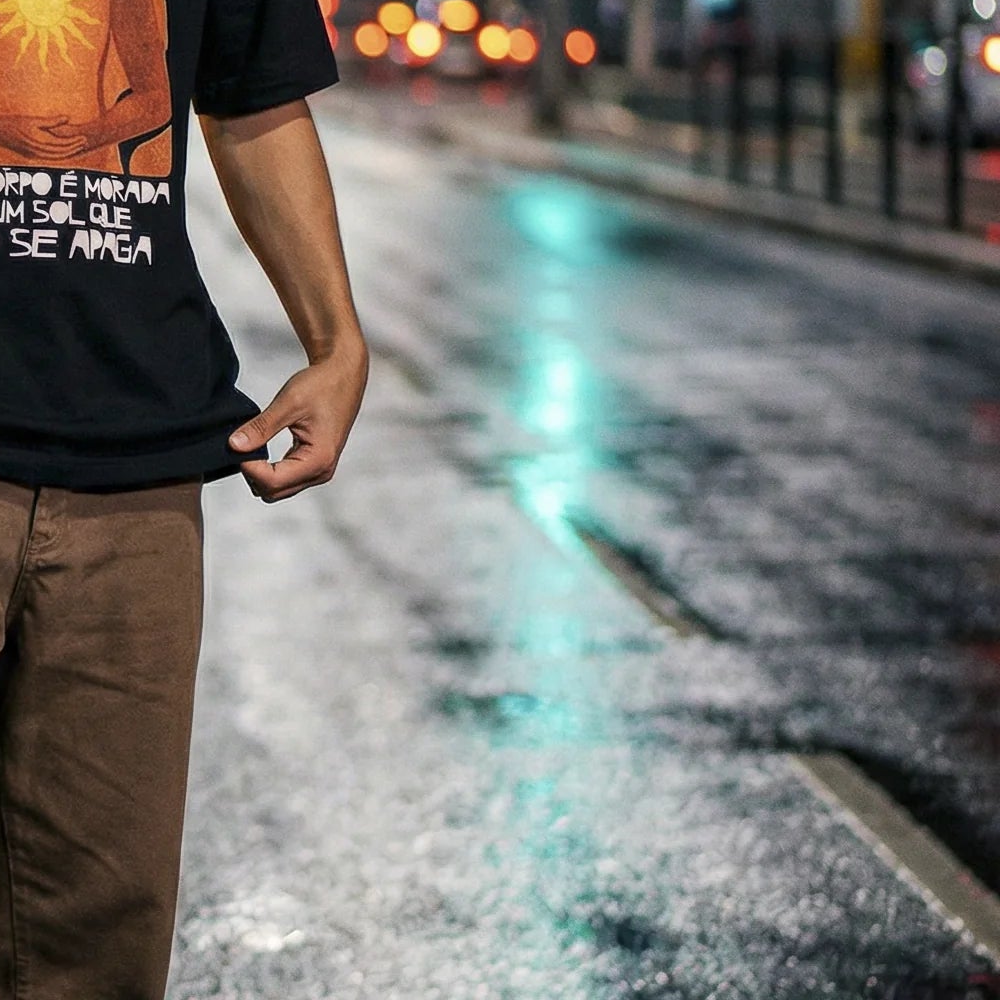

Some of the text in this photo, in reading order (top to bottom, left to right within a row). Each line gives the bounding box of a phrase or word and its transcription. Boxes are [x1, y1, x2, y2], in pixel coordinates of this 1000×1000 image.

[59, 170, 78, 198] É
[84, 174, 171, 205] MORADA
[32, 200, 86, 226] SOL
[89, 202, 133, 230] QUE
[9, 227, 59, 259] SE
[68, 228, 153, 266] APAGA
